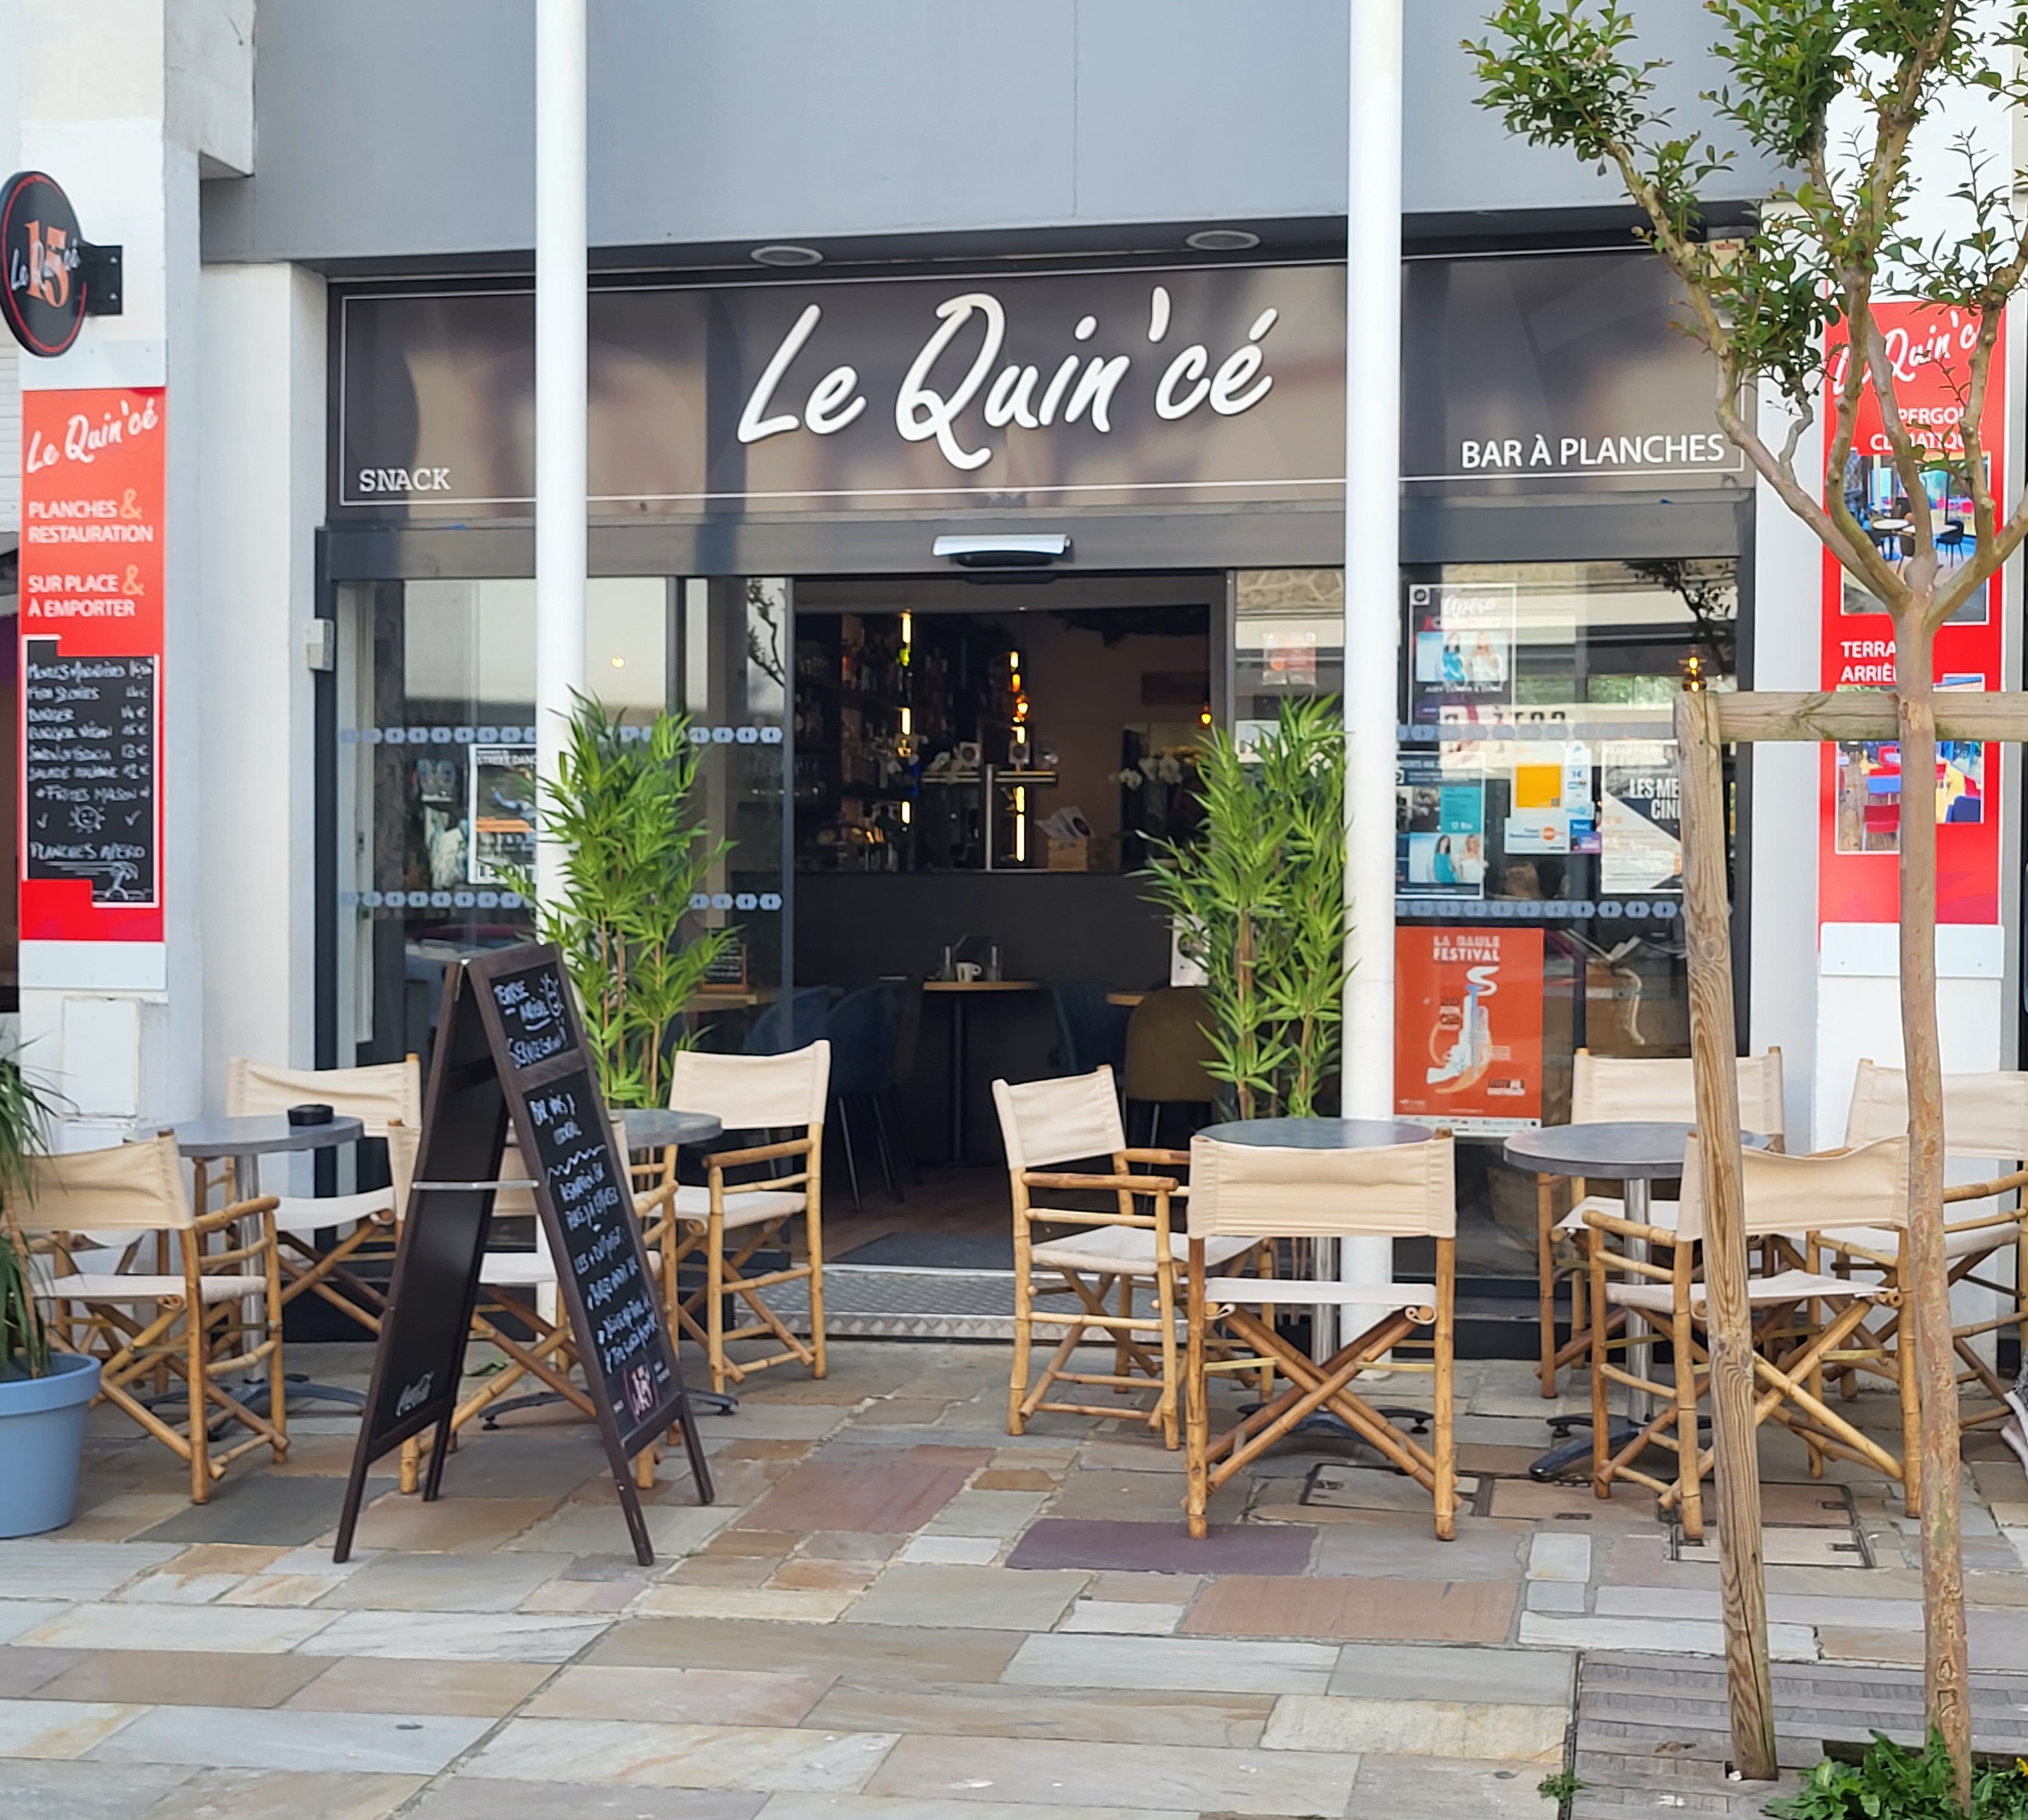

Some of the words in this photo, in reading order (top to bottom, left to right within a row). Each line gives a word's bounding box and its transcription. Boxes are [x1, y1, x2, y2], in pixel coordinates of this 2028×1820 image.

[1884, 309, 1976, 383] Quin'c
[736, 303, 867, 443] Le
[894, 285, 1279, 471] Quin'cé
[1898, 406, 1982, 425] PERGO
[26, 430, 59, 473] Le
[65, 397, 158, 463] Quin'cé
[1461, 440, 1523, 469] BAR
[1529, 433, 1552, 467] À
[1560, 433, 1725, 466] PLANCHES
[359, 468, 451, 492] SNACK
[28, 500, 118, 519] PLANCHES
[121, 488, 143, 520] &
[28, 525, 153, 543] RESTAURATION
[28, 574, 61, 593] SUR
[65, 574, 119, 593] PLACE
[123, 564, 144, 596] &
[44, 599, 135, 618] EMPORTER
[1840, 641, 1896, 658] TERRA
[1840, 662, 1896, 682] ARRIÈ
[1629, 778, 1654, 798] LES
[1656, 778, 1680, 798] ME
[1433, 935, 1450, 946] LA
[1433, 947, 1501, 962] FESTIVAL
